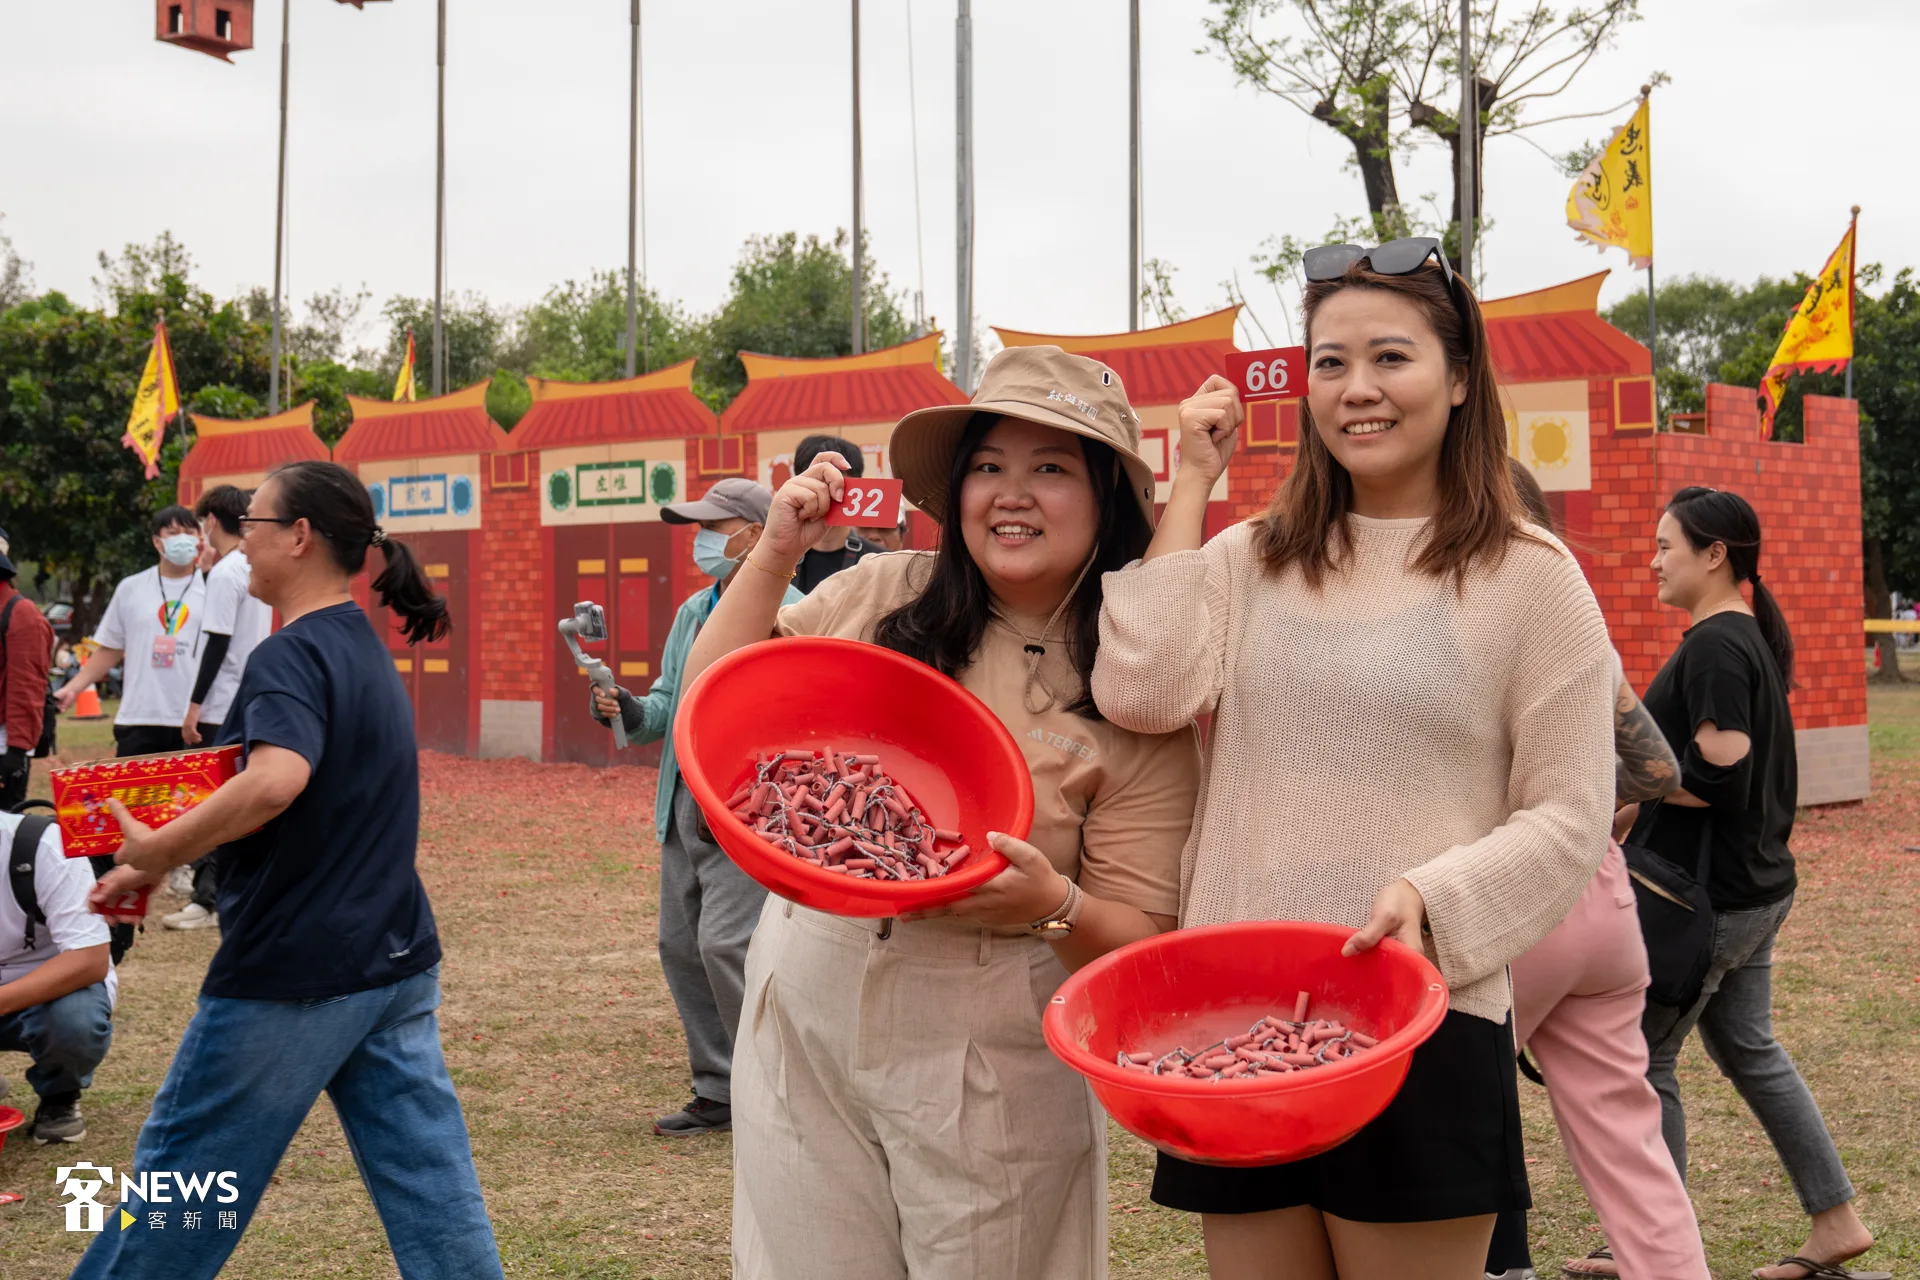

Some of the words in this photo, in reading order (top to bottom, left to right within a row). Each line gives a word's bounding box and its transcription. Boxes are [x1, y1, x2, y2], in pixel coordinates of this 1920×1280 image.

[1245, 358, 1289, 392] 66
[595, 473, 628, 493] 左堆
[842, 487, 884, 517] 32
[1046, 731, 1097, 763] TERREX
